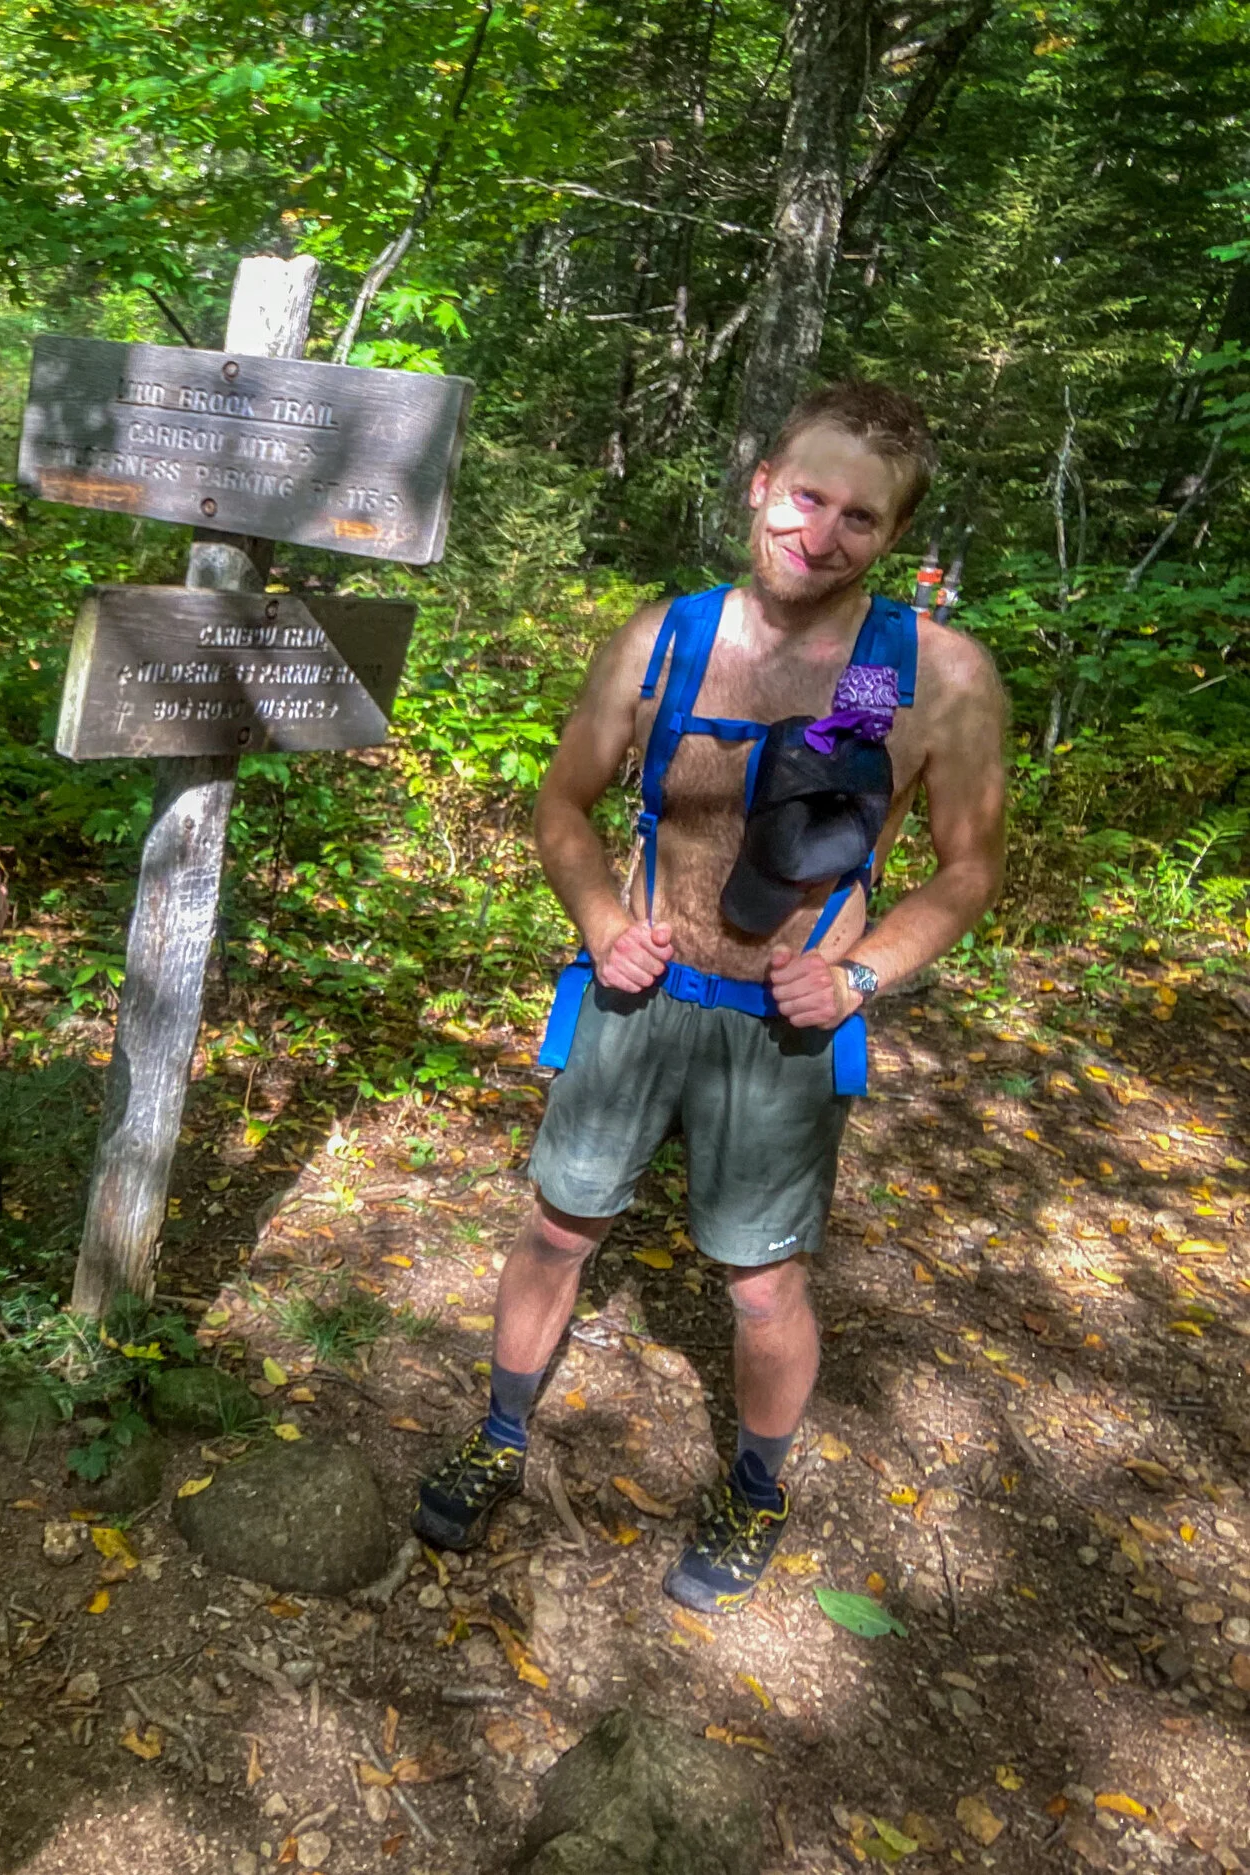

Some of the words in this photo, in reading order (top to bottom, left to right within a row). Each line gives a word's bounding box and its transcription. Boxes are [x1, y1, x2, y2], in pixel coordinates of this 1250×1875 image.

[178, 384, 254, 417] BROOK
[269, 396, 338, 427] TRAIL
[128, 421, 225, 453] CARIBOU
[195, 461, 294, 498] PARKING
[258, 663, 333, 684] PARKING
